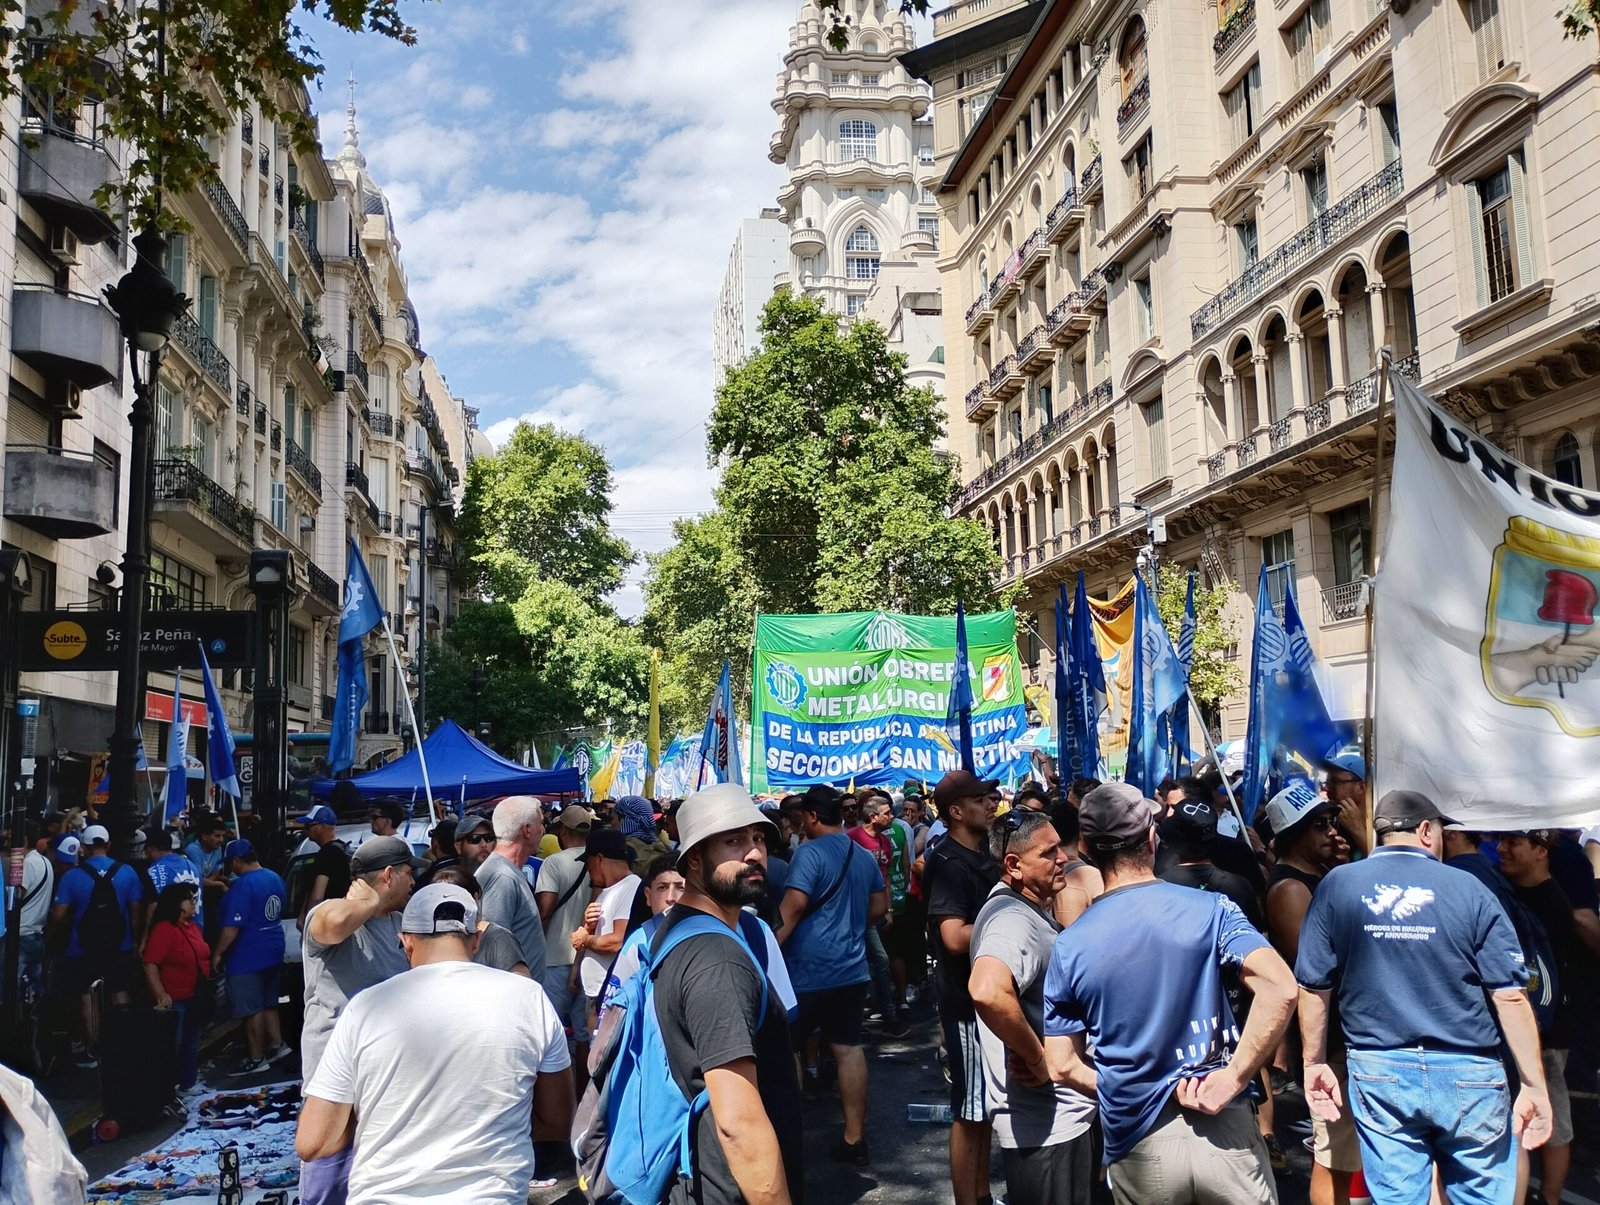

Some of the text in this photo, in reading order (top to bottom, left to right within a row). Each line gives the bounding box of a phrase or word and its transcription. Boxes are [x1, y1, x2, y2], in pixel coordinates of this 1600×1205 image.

[50, 633, 80, 643] Subte
[156, 628, 192, 640] Peña
[151, 644, 175, 653] Mayo
[807, 661, 878, 686] UNIÓN
[808, 682, 979, 716] METALÚRGI
[27, 706, 34, 714] 7
[769, 720, 792, 739] DE
[797, 728, 814, 745] LA
[818, 720, 913, 746] REPÚBLICA
[766, 749, 884, 777] SECCIONAL
[889, 746, 932, 771] SAN
[1364, 924, 1391, 932] HÉROES
[1402, 925, 1436, 934] MALVINAS
[1384, 932, 1429, 940] ANIVERSARIO
